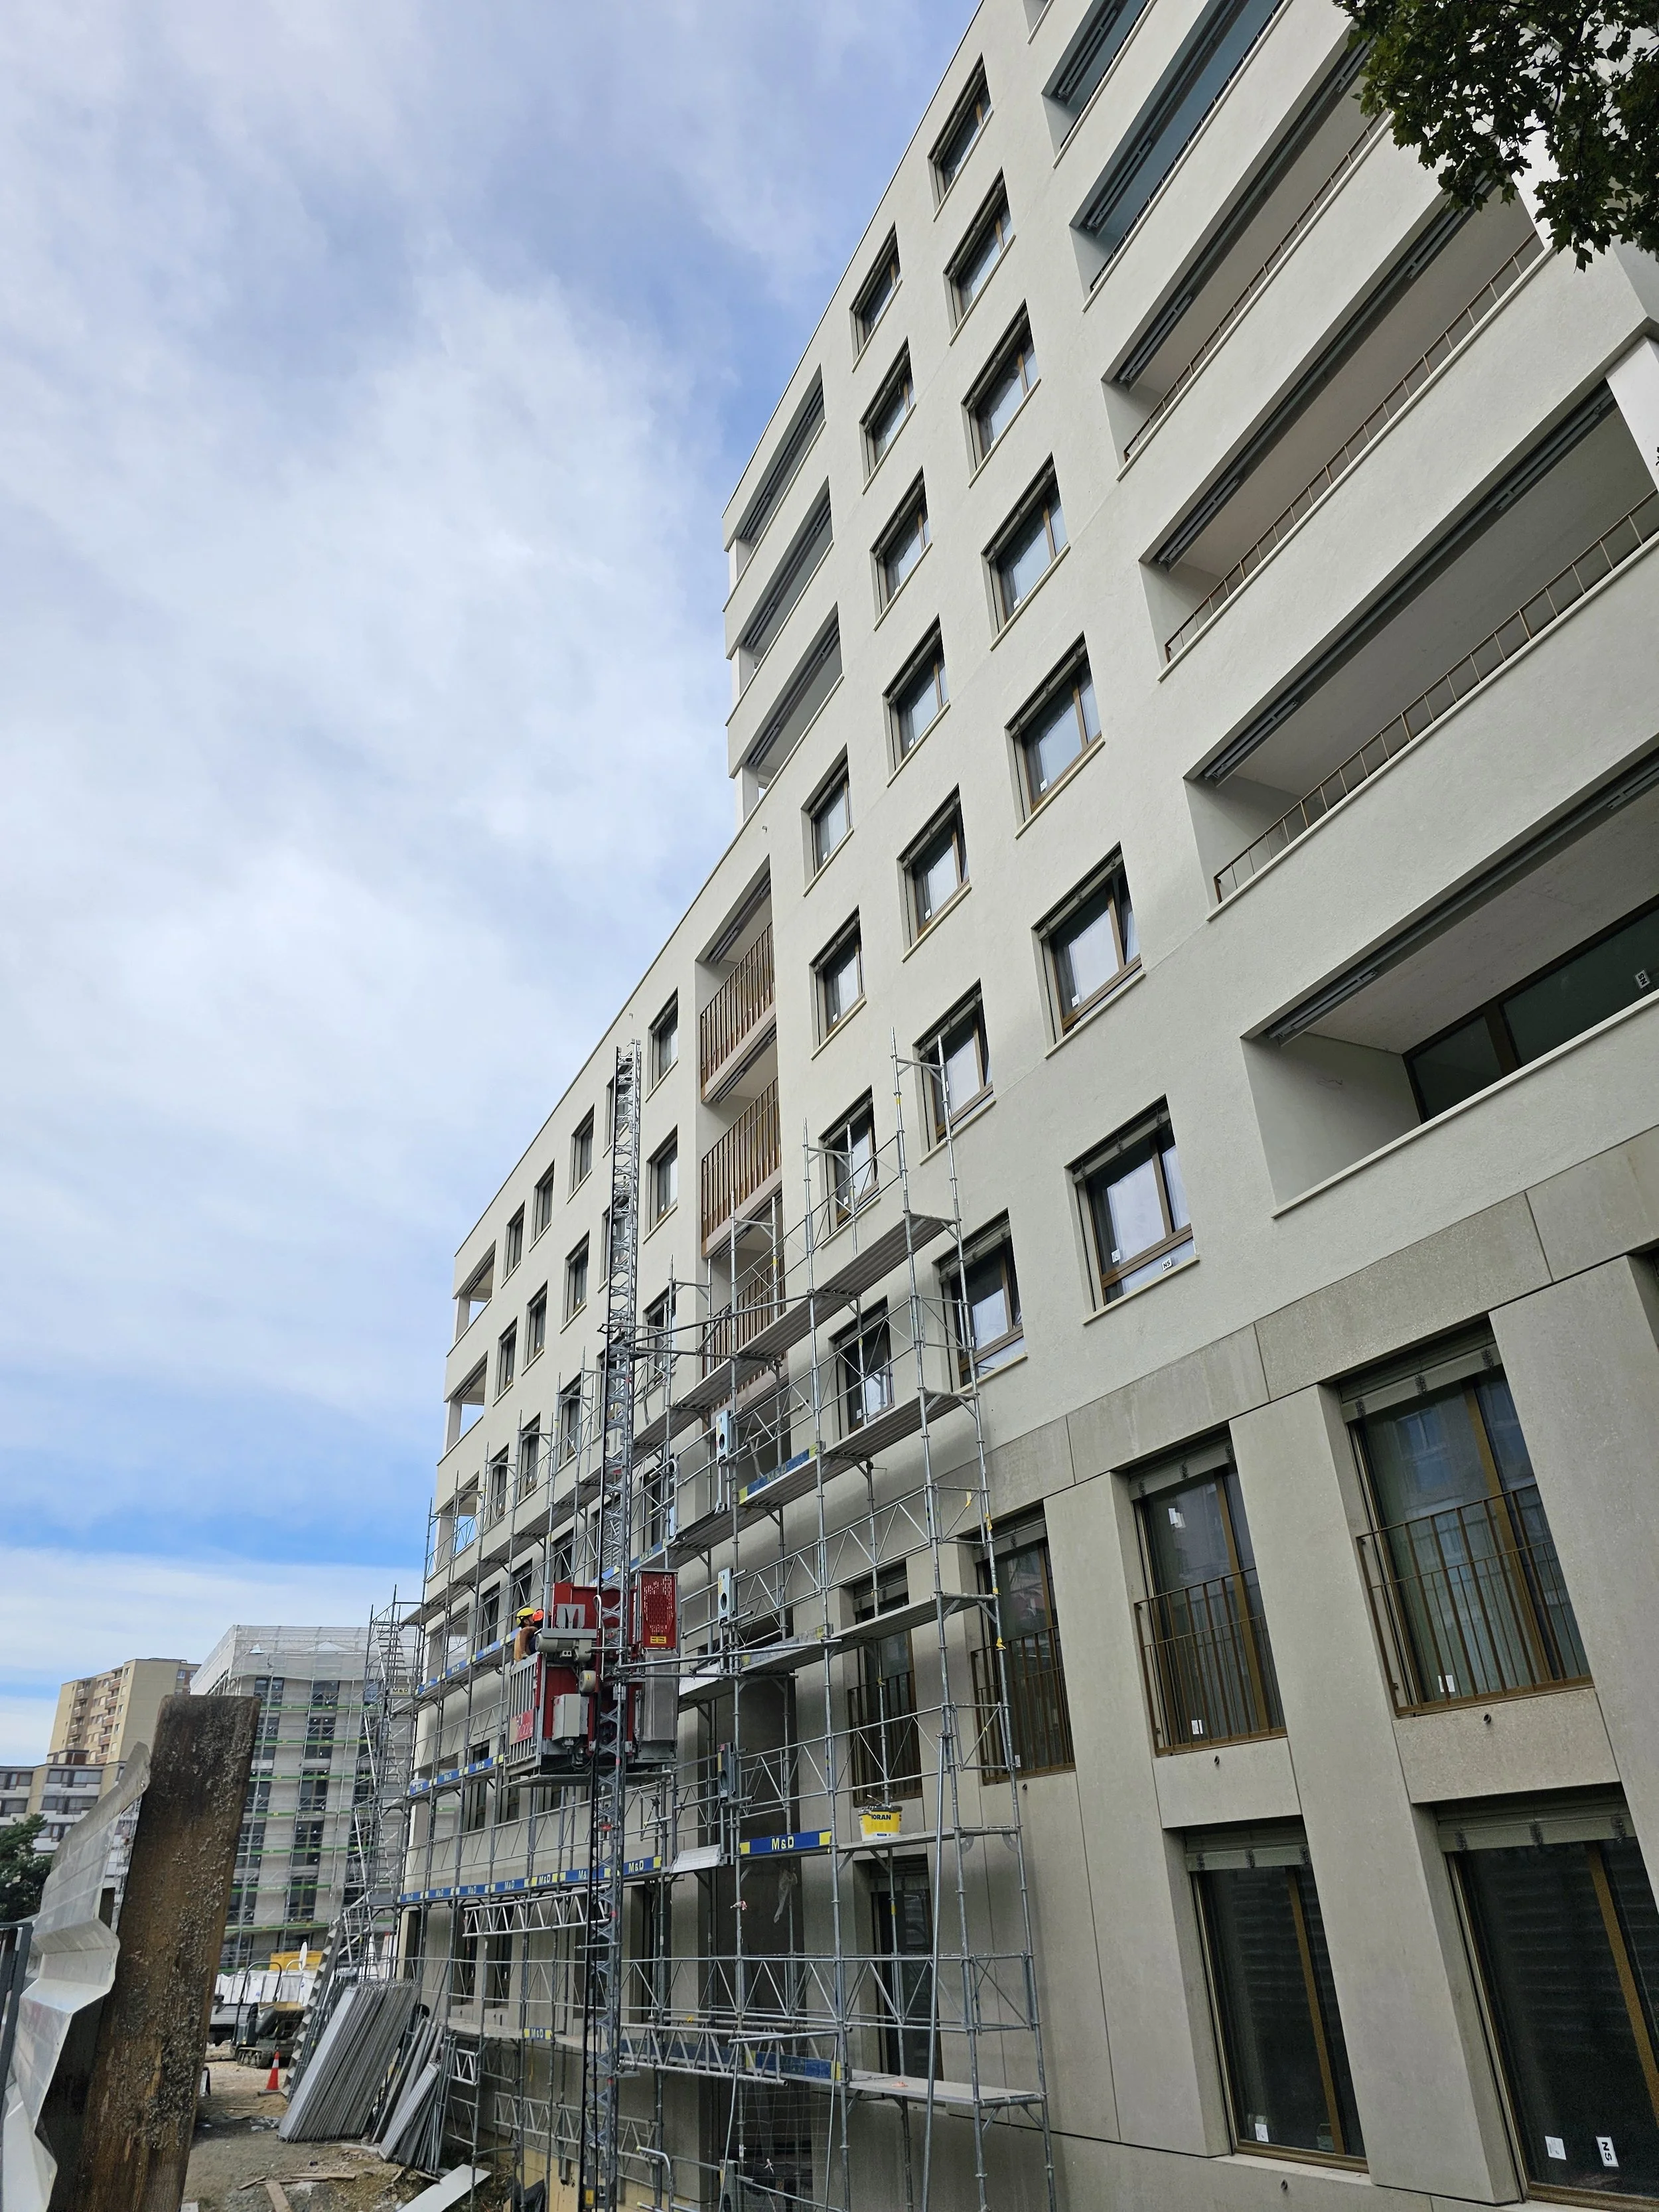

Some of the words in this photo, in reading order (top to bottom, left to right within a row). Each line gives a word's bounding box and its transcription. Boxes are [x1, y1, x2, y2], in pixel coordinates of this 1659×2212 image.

[771, 1836, 794, 1850] M&D
[628, 1860, 644, 1873] M&D
[539, 1874, 550, 1884] M&D
[504, 1880, 515, 1889] M&D
[531, 2028, 543, 2038] M&D
